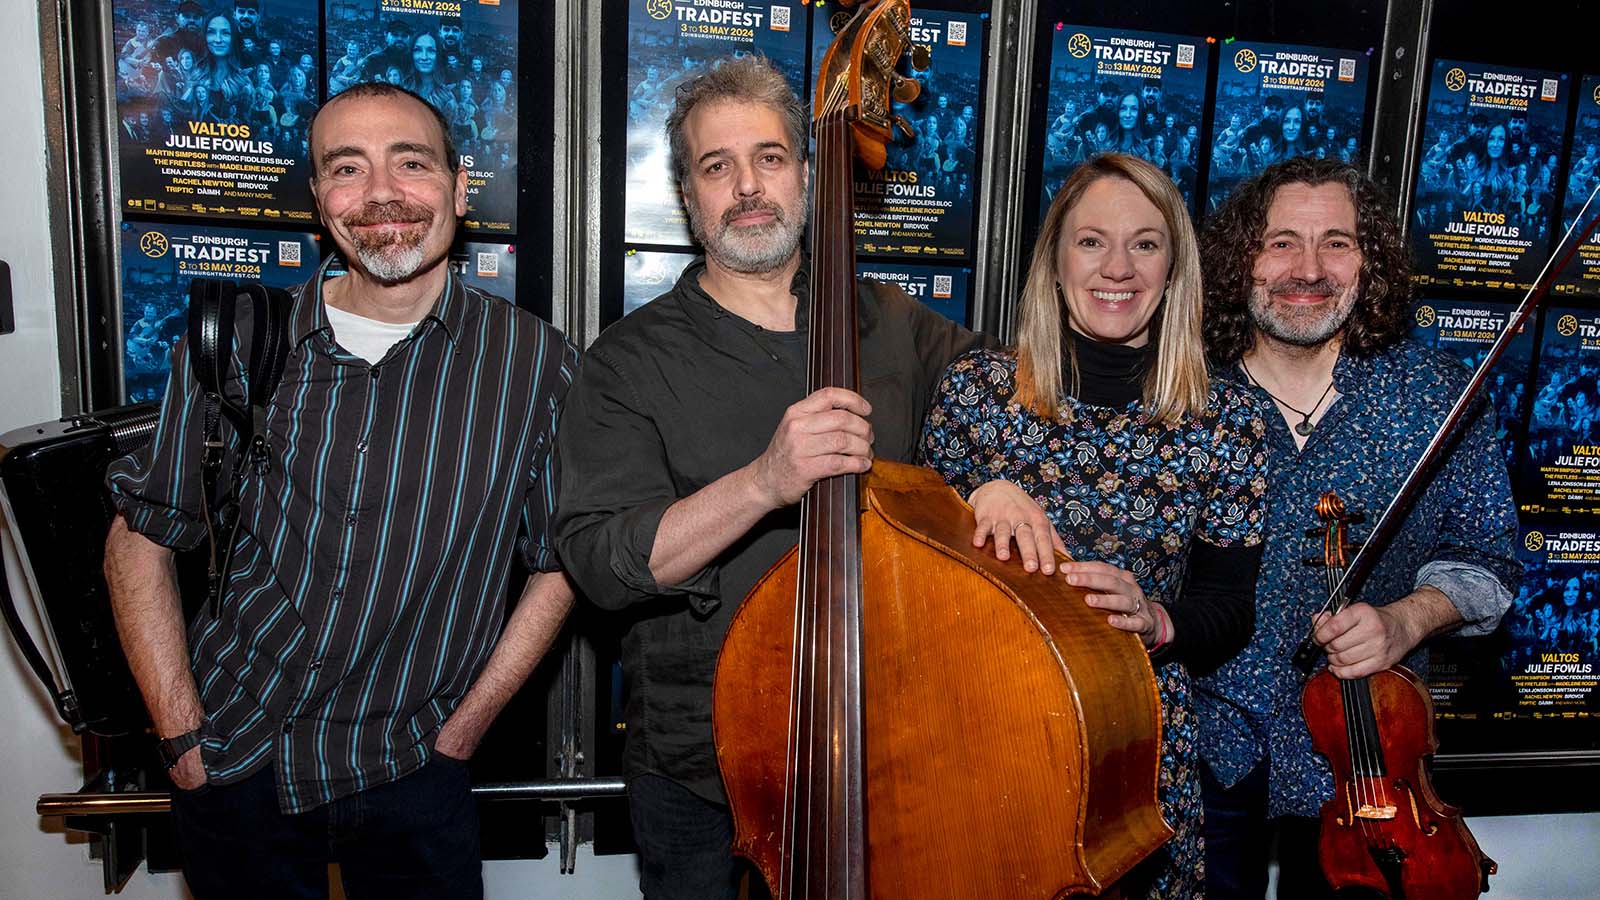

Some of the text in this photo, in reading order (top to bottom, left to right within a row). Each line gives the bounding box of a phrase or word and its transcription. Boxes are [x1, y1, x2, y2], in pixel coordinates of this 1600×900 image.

[413, 0, 434, 9] MAY
[436, 2, 461, 12] 2024
[694, 0, 744, 10] EDINBURGH
[675, 6, 764, 28] TRADFEST
[681, 24, 688, 32] 3
[698, 25, 709, 33] 13
[710, 26, 730, 34] MAY
[730, 28, 754, 37] 2024
[1110, 38, 1154, 48] EDINBURGH
[1094, 46, 1171, 64] TRADFEST
[1276, 52, 1318, 62] EDINBURGH
[1098, 61, 1104, 70] 3
[1114, 62, 1122, 70] 13
[1123, 64, 1140, 72] MAY
[1141, 65, 1161, 74] 2024
[1259, 60, 1333, 78] TRADFEST
[1288, 78, 1304, 86] MAY
[1305, 79, 1324, 88] 2024
[1483, 72, 1522, 82] EDINBURGH
[1468, 80, 1537, 98] TRADFEST
[1510, 98, 1528, 106] 2024
[188, 121, 250, 138] VALTOS
[166, 135, 274, 154] JULIE FOWLIS
[175, 151, 208, 159] SIMPSON
[240, 156, 274, 164] FIDDLERS
[170, 160, 206, 168] FRETLESS
[220, 164, 260, 172] MADELEINE
[182, 170, 216, 178] JONSSON
[223, 172, 258, 180] BRITTANY
[165, 186, 194, 194] TRIPTIC
[173, 178, 268, 190] RACHEL NEWTON BIRDVOX
[886, 184, 935, 197] FOWLIS
[1463, 212, 1505, 224] VALTOS
[1445, 223, 1519, 237] JULIE FOWLIS
[192, 236, 248, 246] EDINBURGH
[172, 244, 270, 264] TRADFEST
[179, 261, 186, 270] 3
[199, 262, 210, 270] 13
[211, 263, 232, 272] MAY
[234, 265, 260, 274] 2024
[180, 270, 260, 278] EDINBURGHTRADFEST.COM
[1437, 316, 1504, 330] TRADFEST
[1556, 456, 1584, 466] JULIE
[1546, 540, 1600, 551] TRADFES
[1541, 653, 1579, 662] VALTOS
[1525, 664, 1592, 673] JULIE FOWLIS
